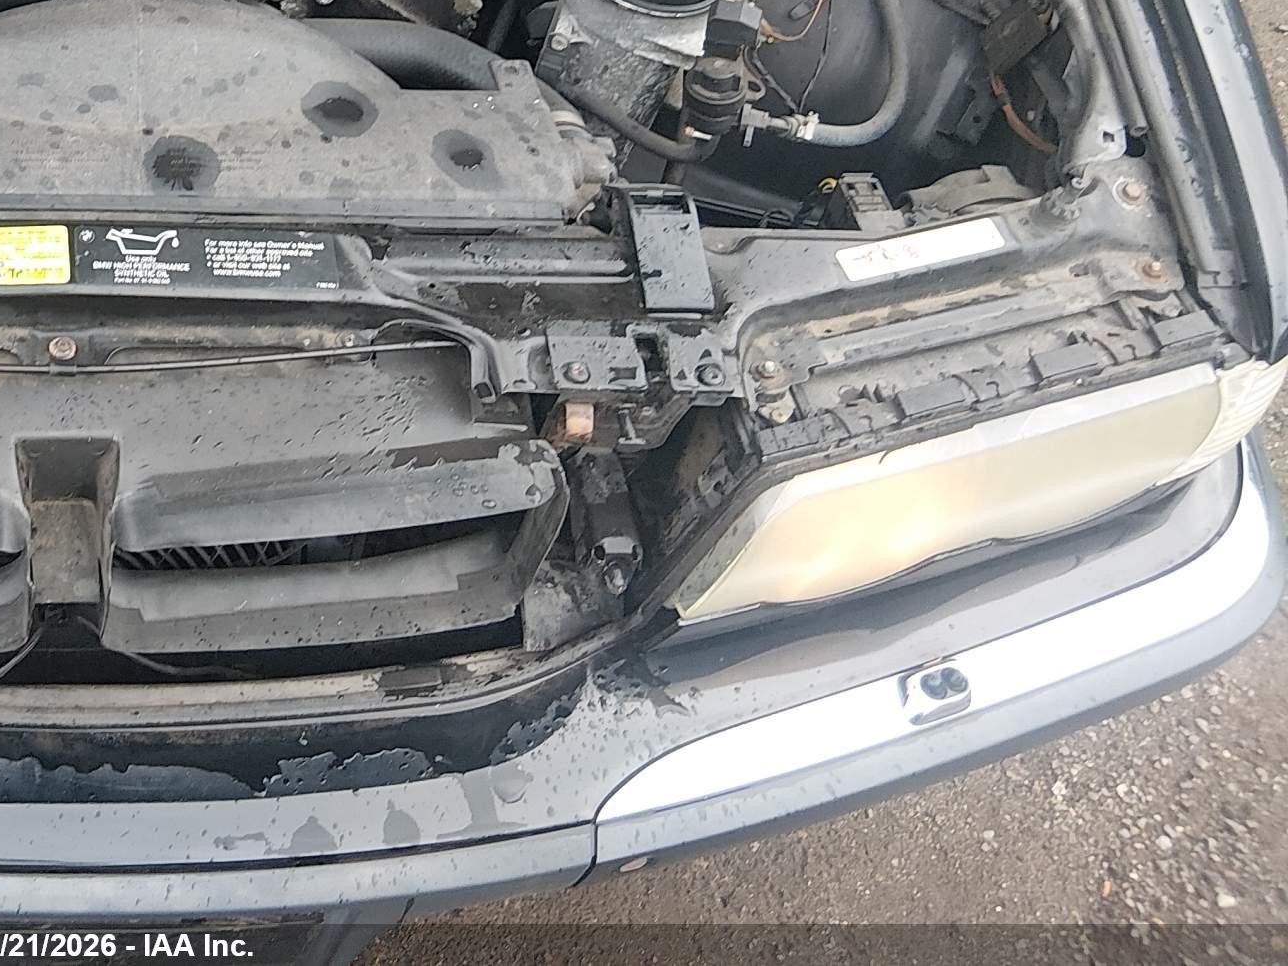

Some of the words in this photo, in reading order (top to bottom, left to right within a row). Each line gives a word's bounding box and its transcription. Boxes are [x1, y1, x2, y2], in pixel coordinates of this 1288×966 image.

[204, 239, 217, 247] For
[218, 240, 237, 248] more
[92, 261, 112, 270] BMW
[133, 262, 191, 272] PERFORMANCE
